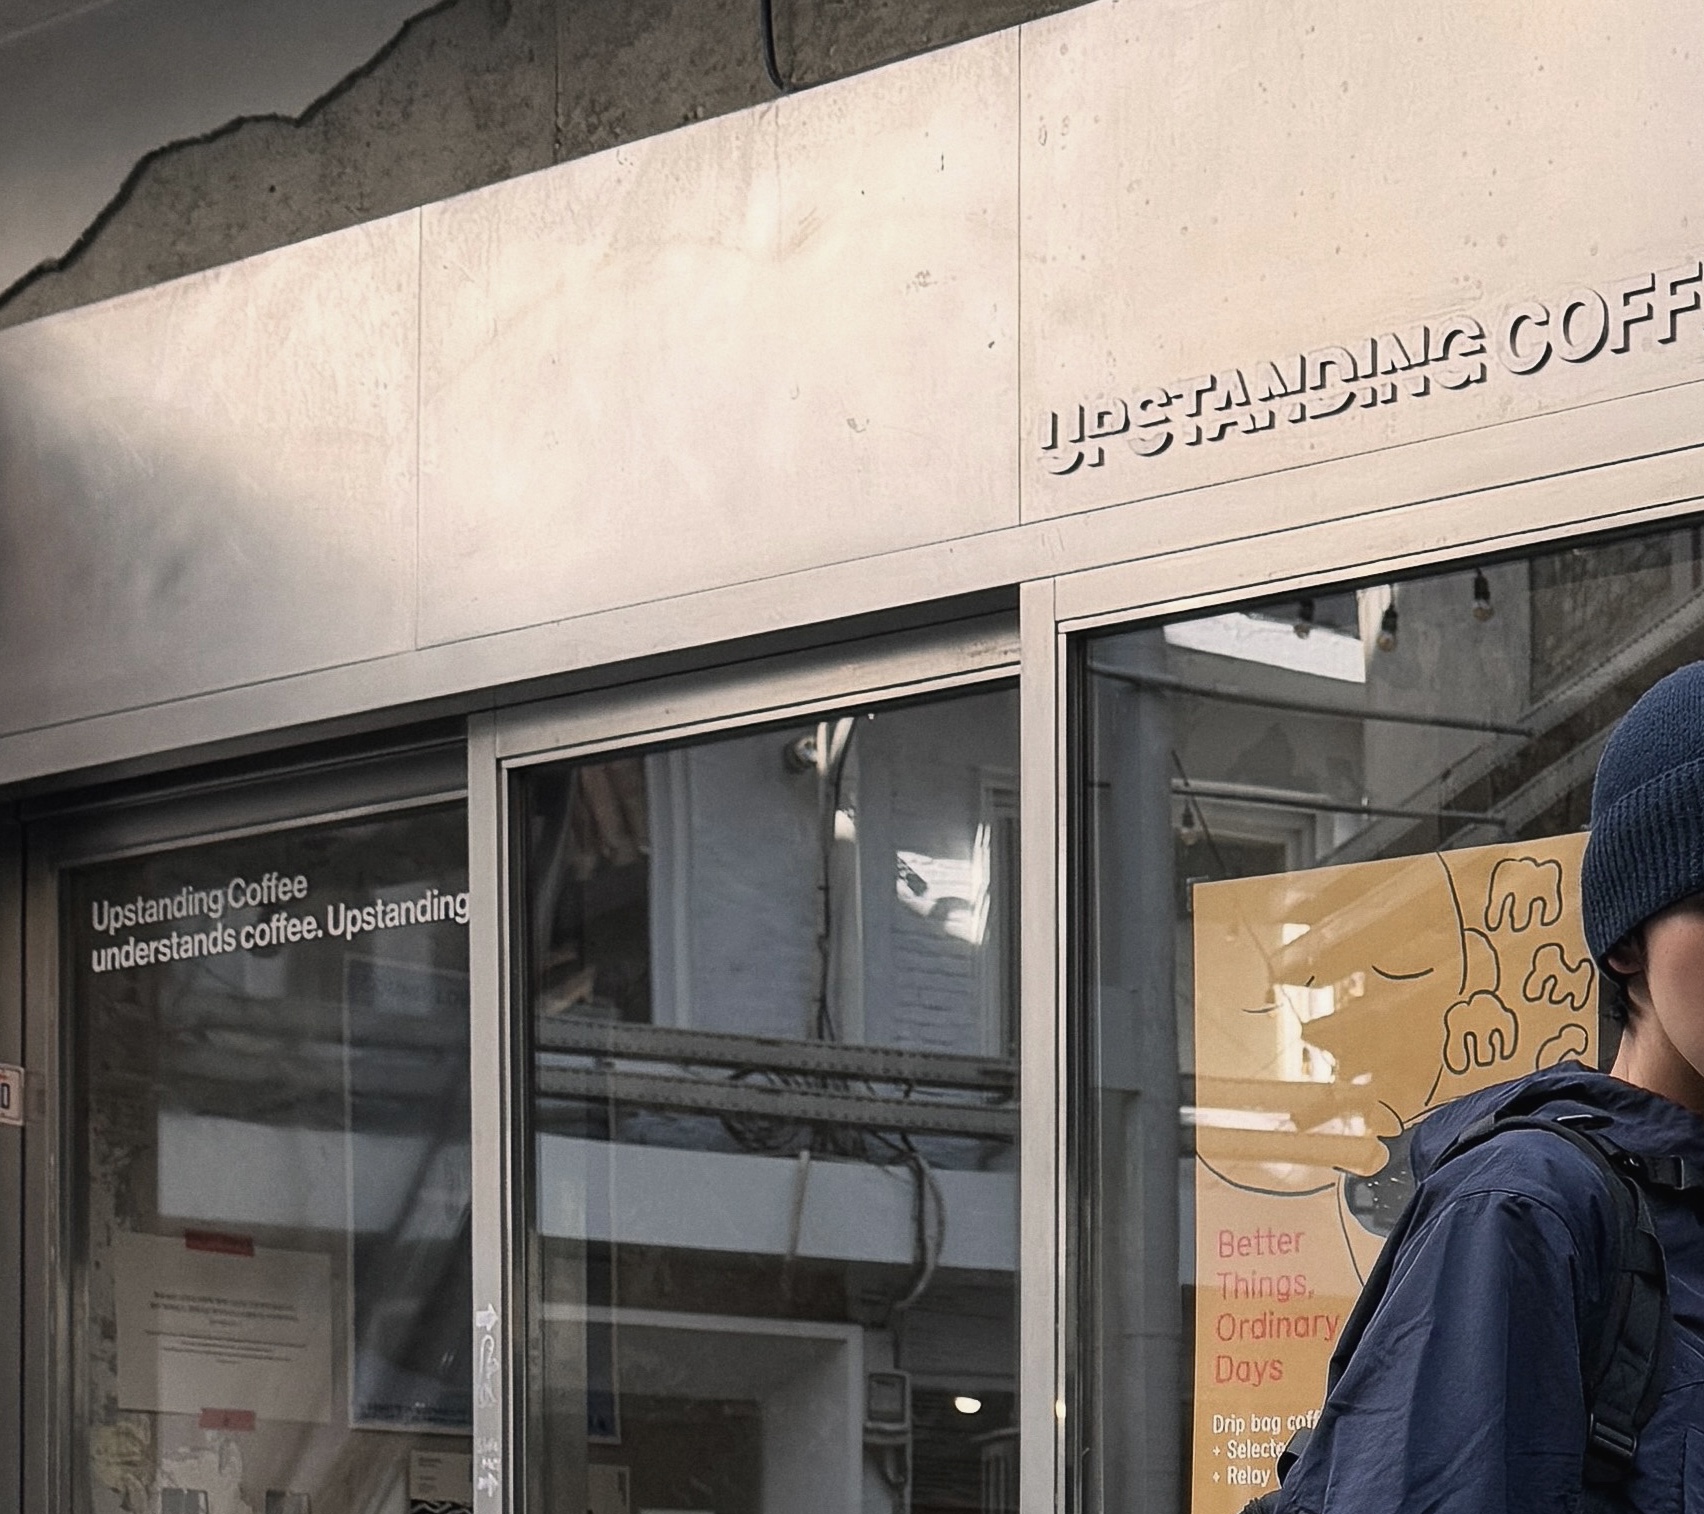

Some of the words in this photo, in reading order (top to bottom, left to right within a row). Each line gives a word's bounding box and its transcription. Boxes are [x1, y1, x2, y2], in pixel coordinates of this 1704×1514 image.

[1040, 314, 1488, 475] UPSTANDING
[92, 885, 225, 935] Upstanding
[227, 873, 308, 909] Coffee
[92, 924, 236, 973] understands
[240, 910, 323, 950] coffee.
[327, 889, 470, 940] Upstanding
[1218, 1228, 1305, 1258] Better
[1216, 1270, 1315, 1302] Things,
[1216, 1311, 1342, 1342] Ordinary
[1215, 1354, 1284, 1387] Days
[1213, 1414, 1245, 1436] Drip
[1250, 1413, 1282, 1435] bag
[1227, 1465, 1271, 1488] Relay
